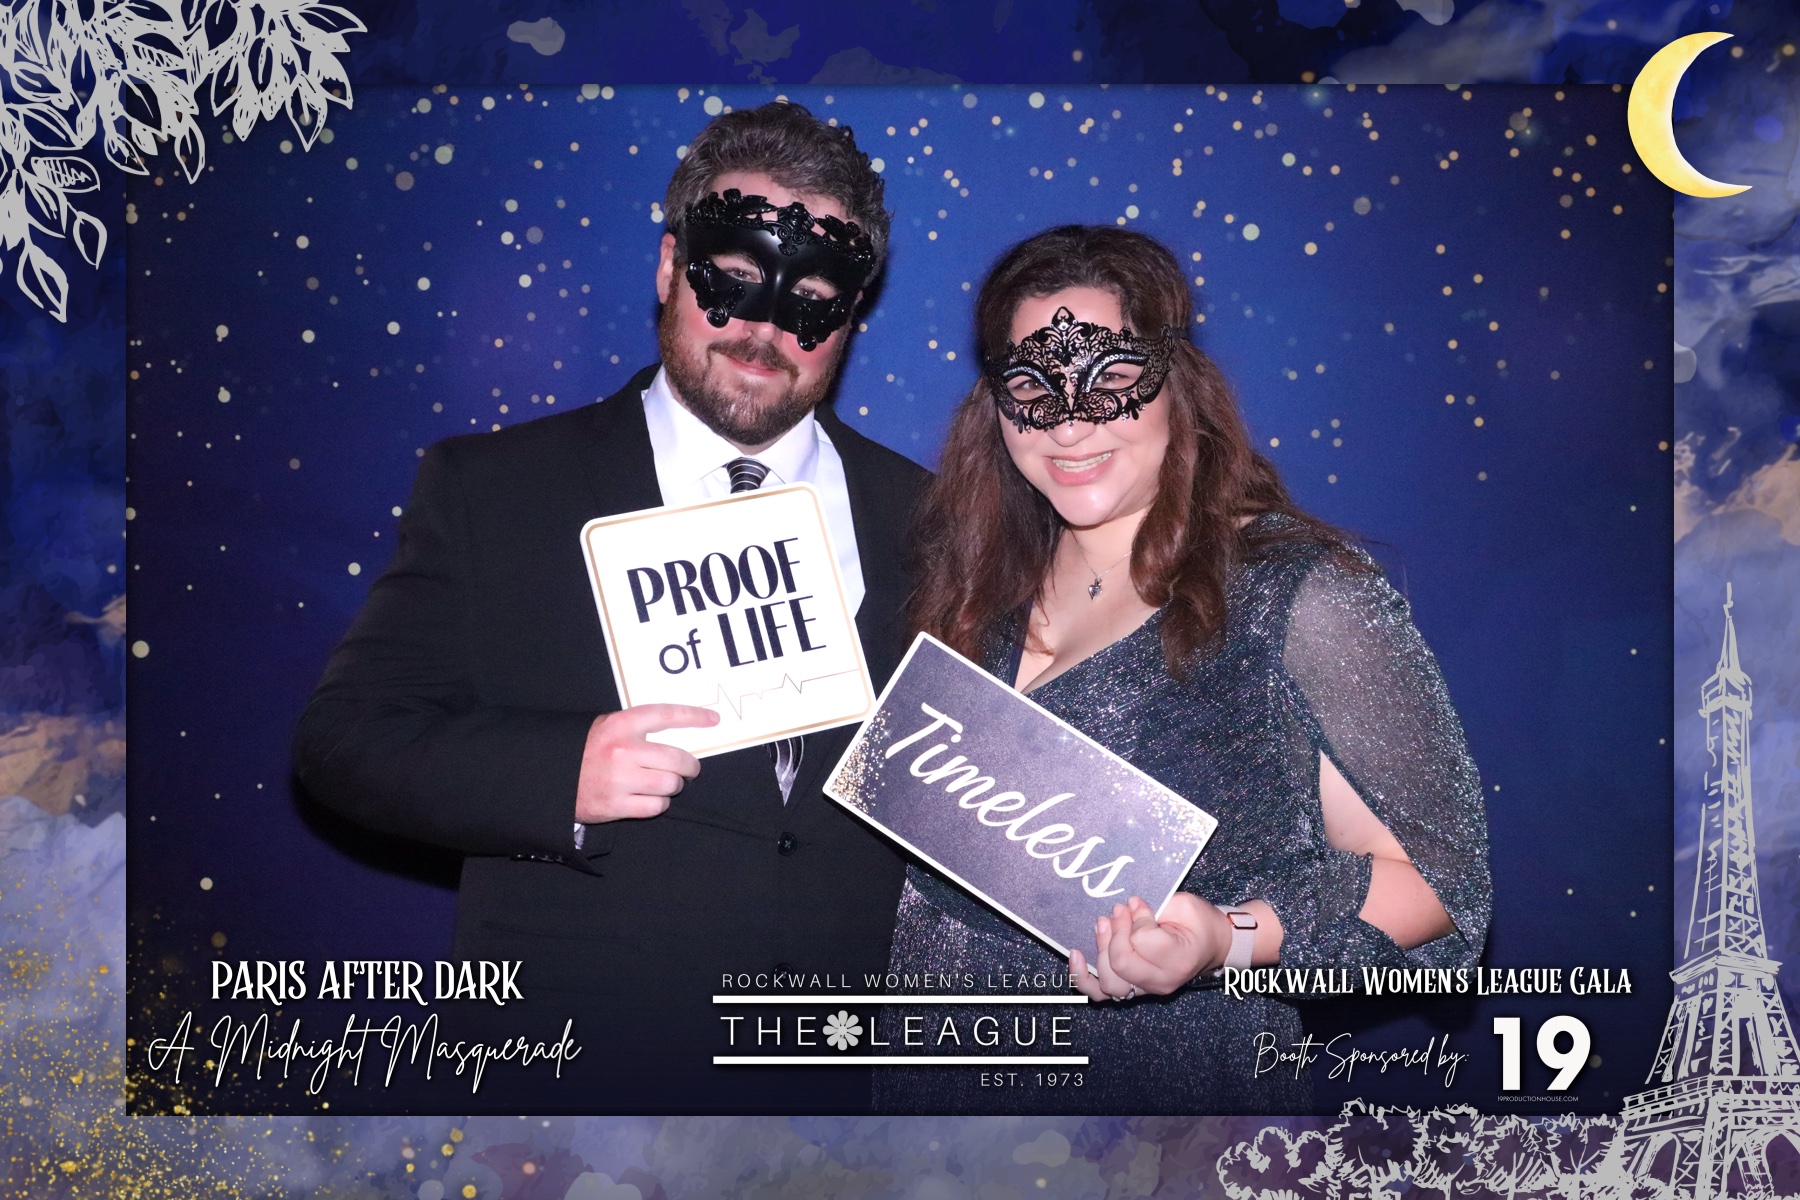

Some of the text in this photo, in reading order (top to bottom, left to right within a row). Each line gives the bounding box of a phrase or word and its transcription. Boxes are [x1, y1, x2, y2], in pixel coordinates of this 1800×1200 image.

[626, 537, 800, 623] PROOF
[658, 595, 827, 675] of LIFE
[885, 702, 1135, 898] Timeless
